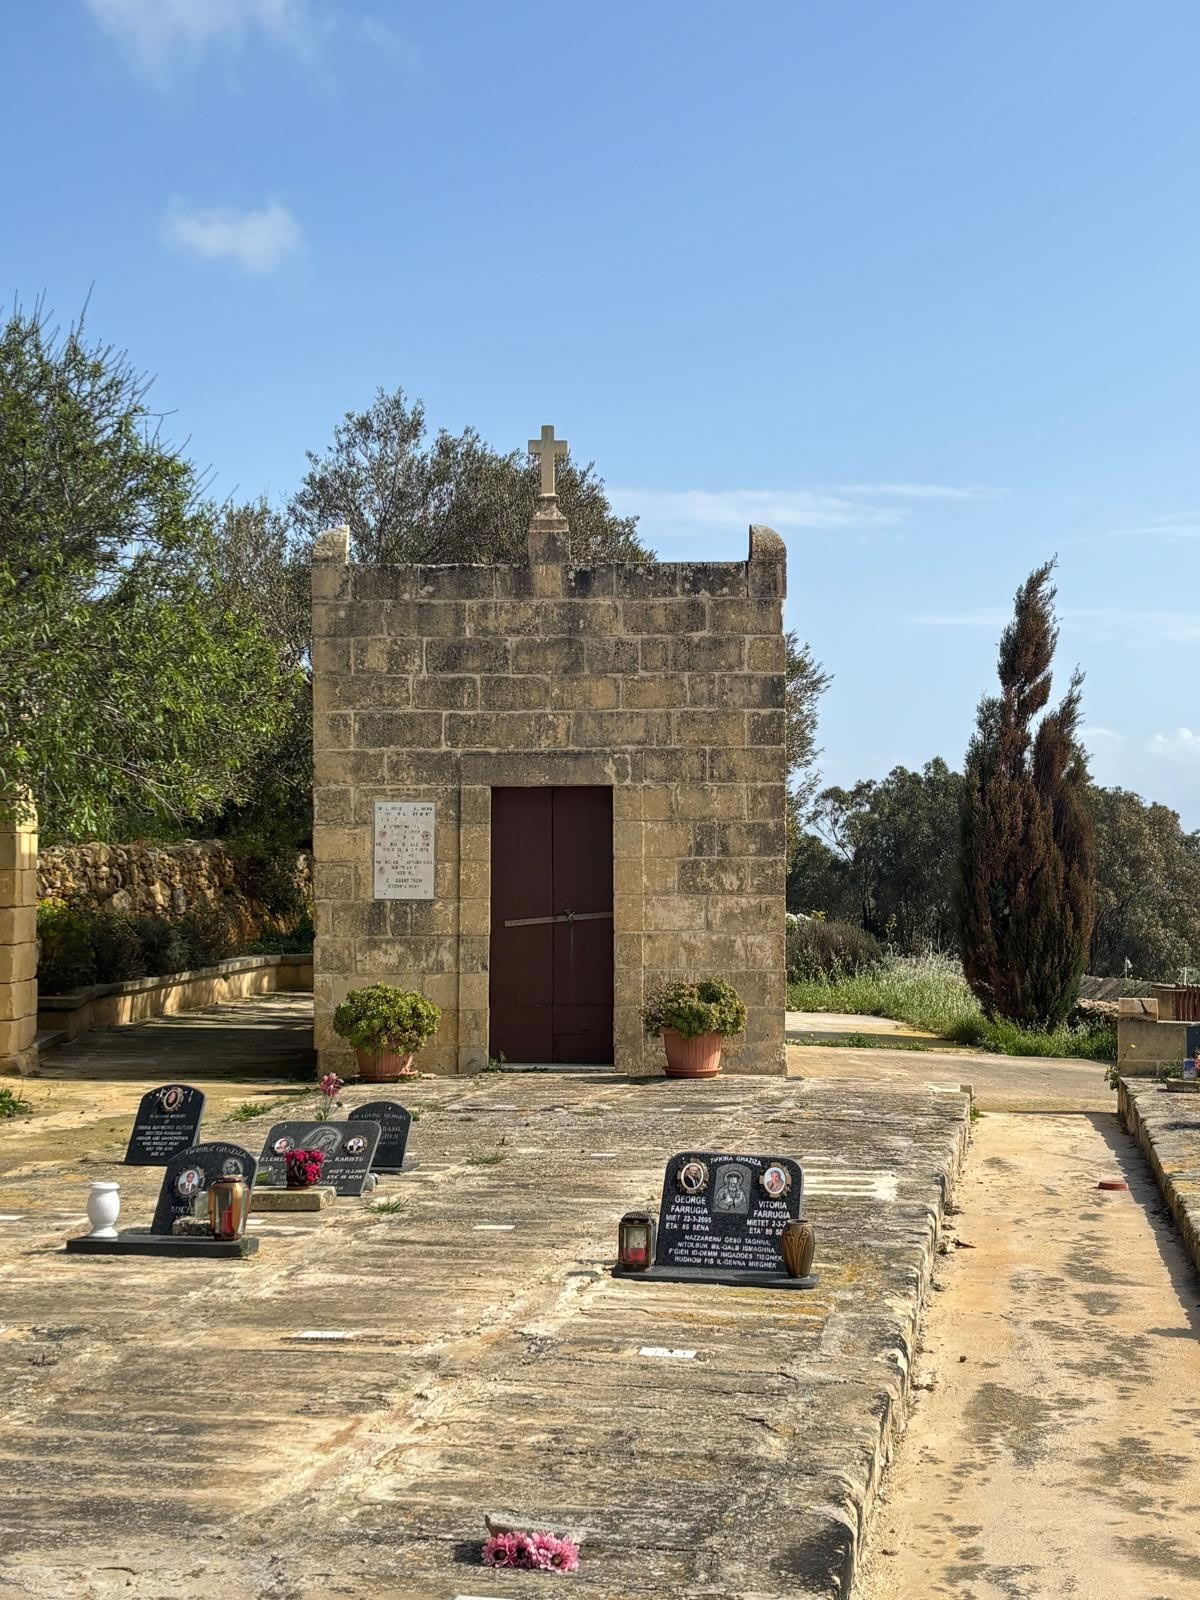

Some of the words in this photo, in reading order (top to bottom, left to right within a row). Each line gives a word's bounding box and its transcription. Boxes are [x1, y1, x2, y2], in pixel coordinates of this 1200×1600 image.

[674, 1195, 707, 1205] GEORGE
[758, 1200, 787, 1209] VITORIA
[670, 1205, 708, 1214] FARRUGIA
[753, 1210, 790, 1219] FARRUGIA
[746, 1219, 769, 1227] MIETET
[684, 1234, 722, 1242] NAZZARENU
